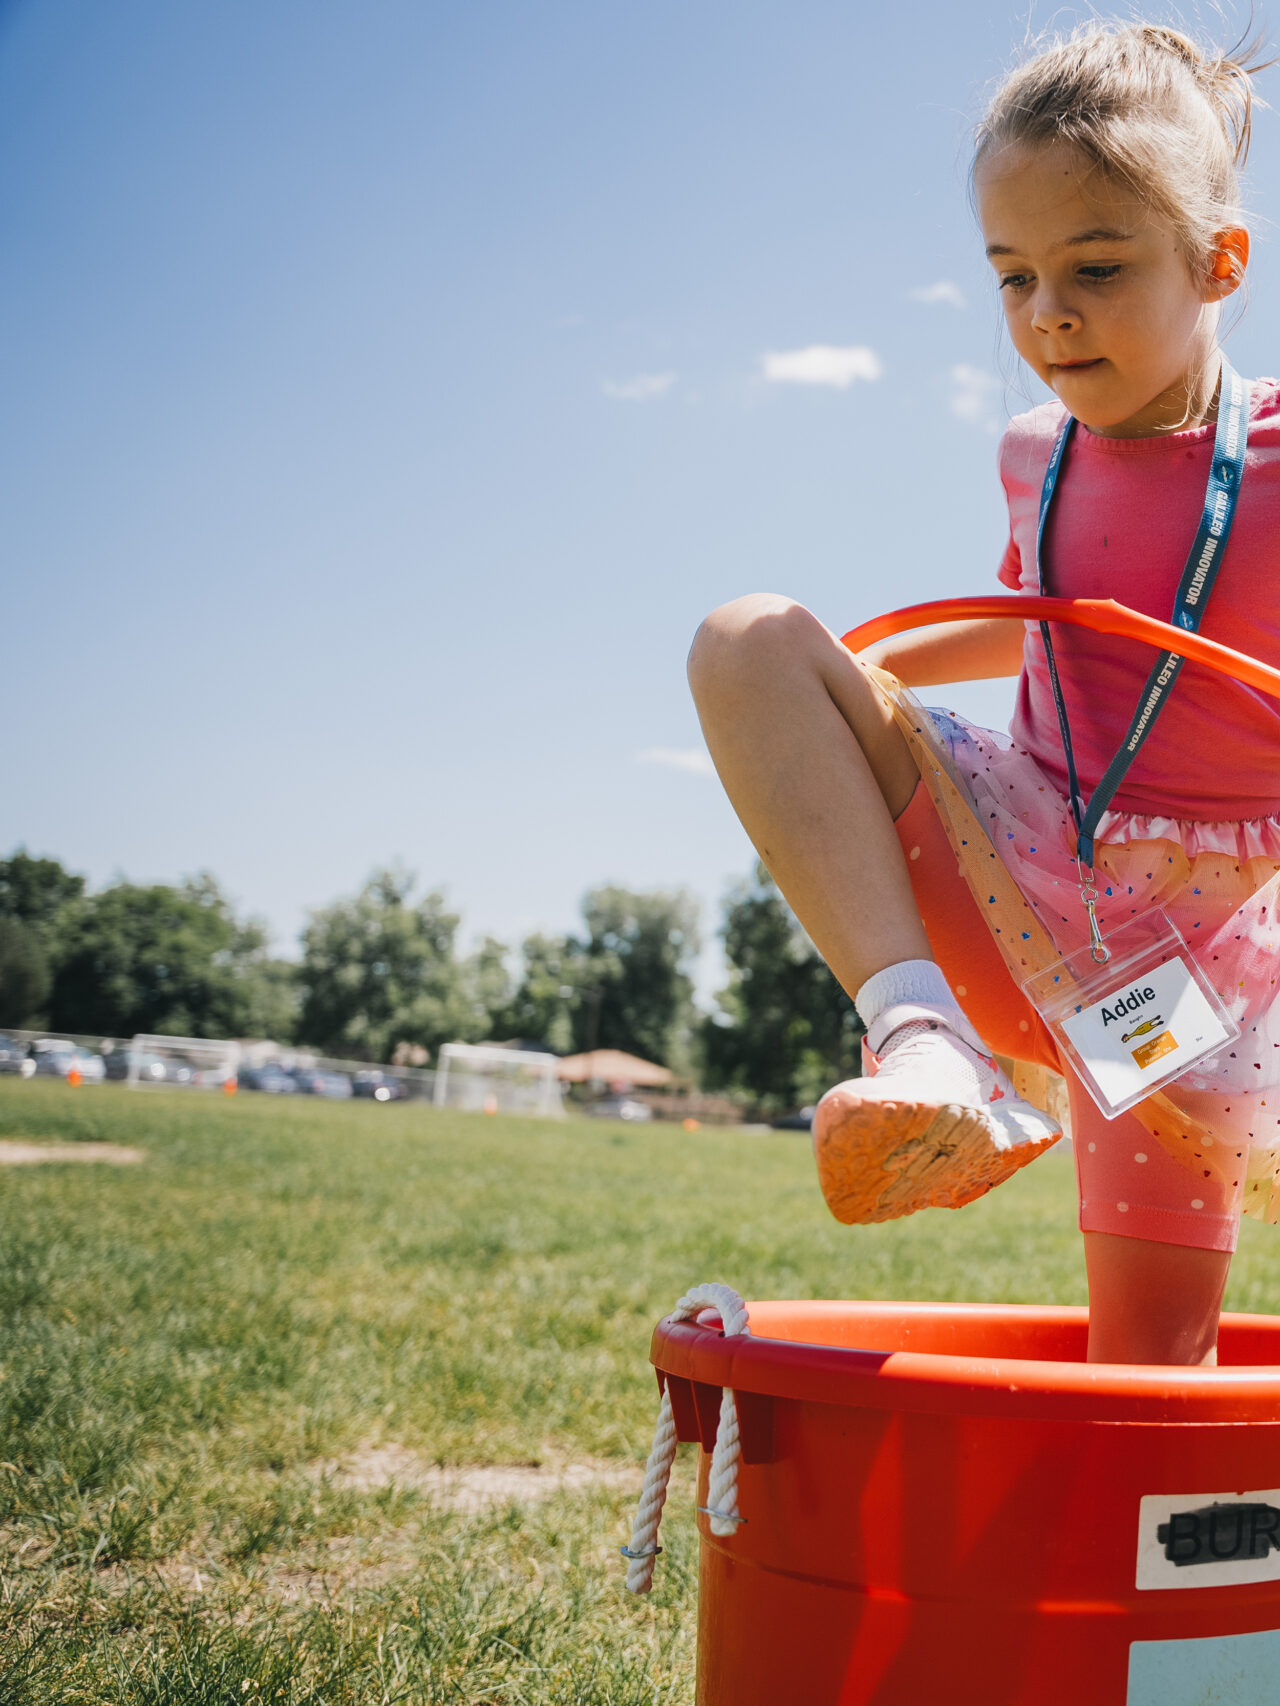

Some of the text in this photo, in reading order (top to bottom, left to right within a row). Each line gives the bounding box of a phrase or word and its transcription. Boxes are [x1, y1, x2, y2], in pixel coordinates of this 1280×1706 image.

[1185, 489, 1228, 606] GALILEO INNOVATOR
[1127, 652, 1180, 752] LILEO INNOVATOR
[1101, 987, 1156, 1027] Addie
